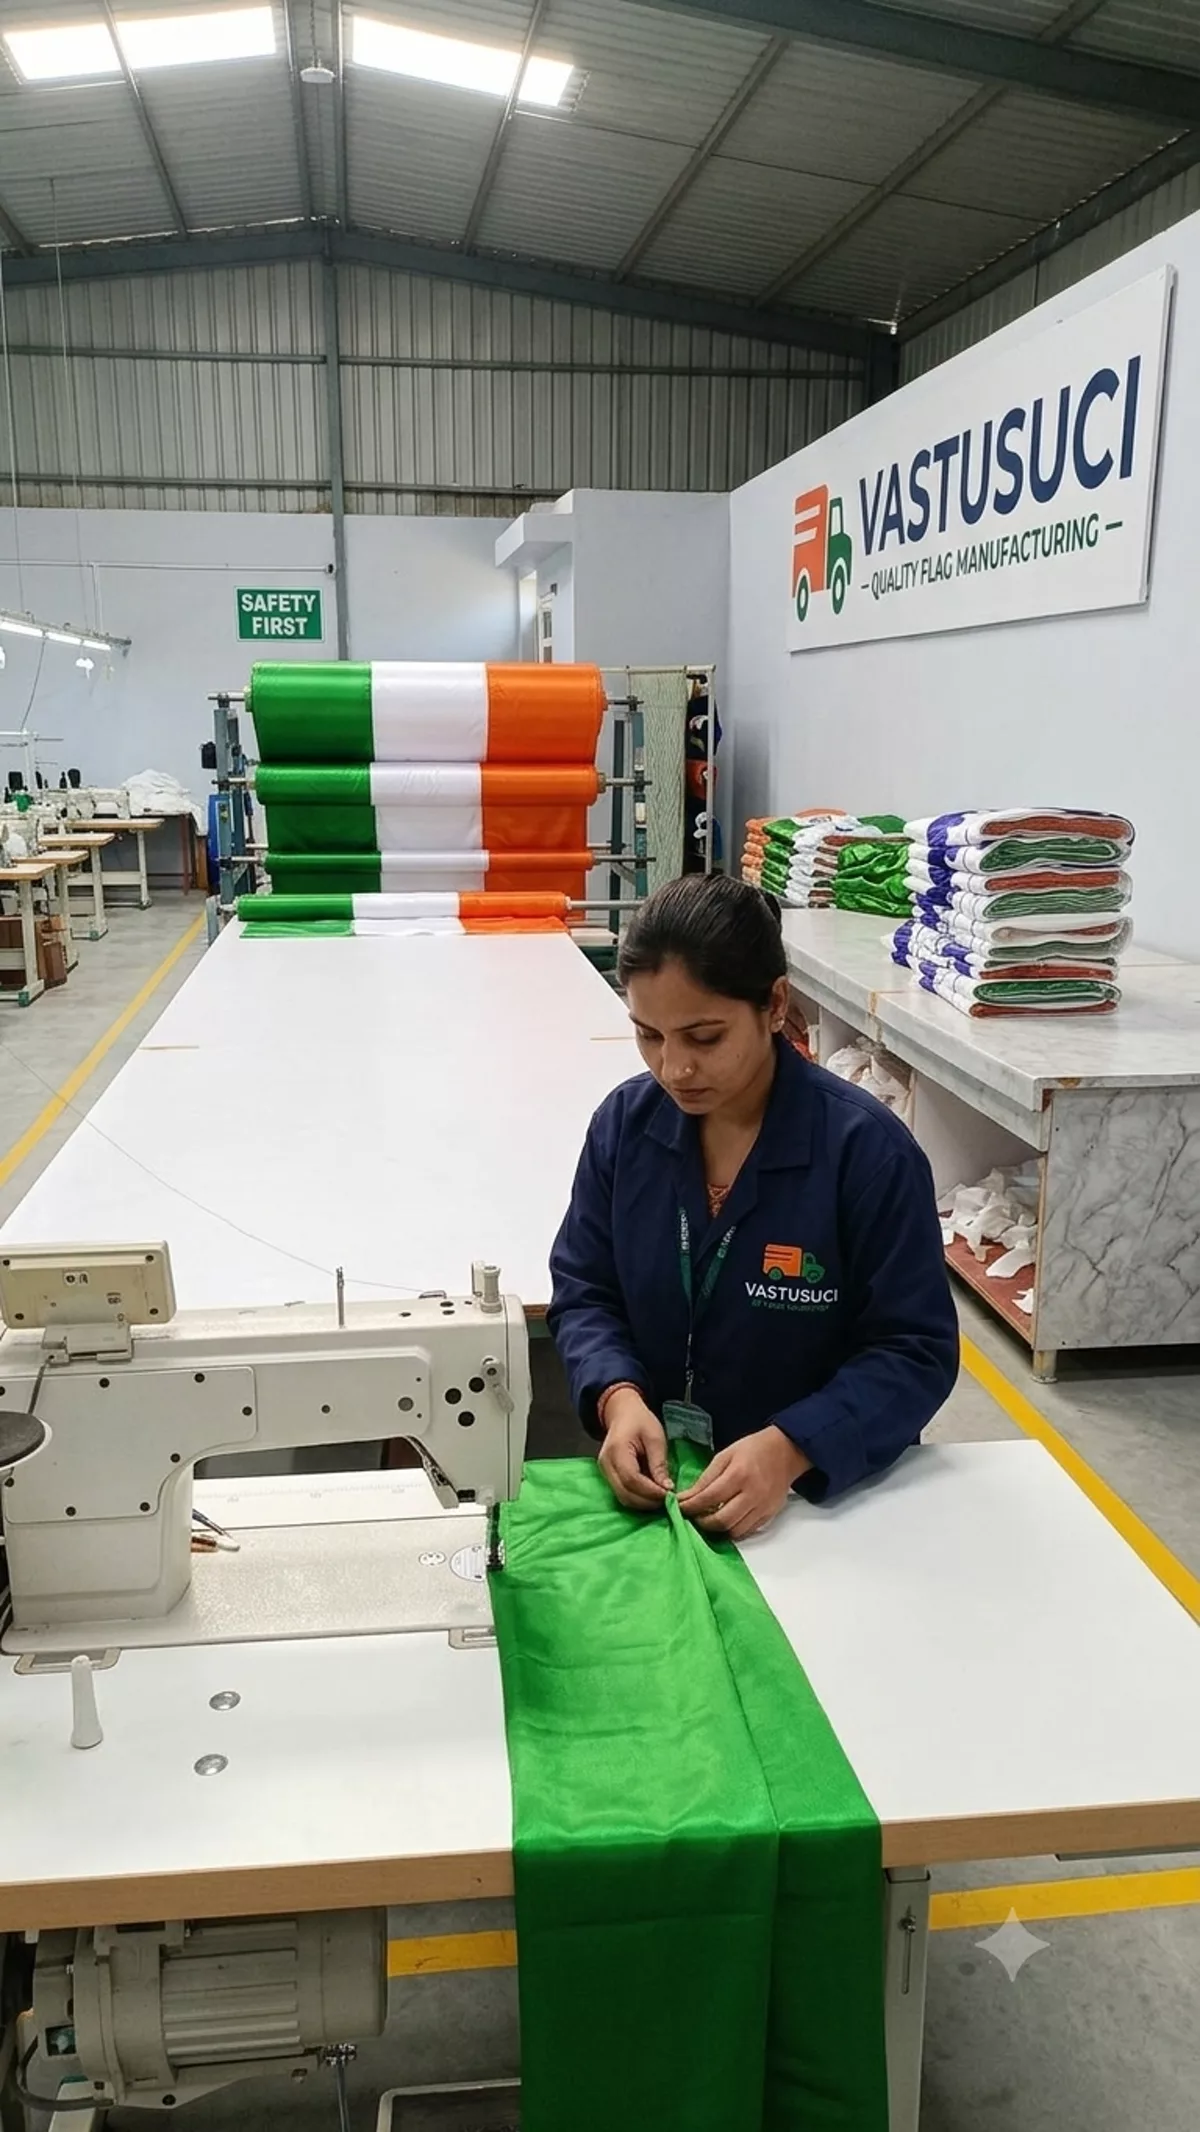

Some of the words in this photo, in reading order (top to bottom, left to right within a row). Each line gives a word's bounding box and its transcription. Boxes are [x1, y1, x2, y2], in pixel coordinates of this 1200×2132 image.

[859, 355, 1141, 556] VASTUSUCI
[871, 560, 920, 600] QUALITY
[921, 552, 953, 585] FLAG
[956, 513, 1099, 577] MANUFACTURING
[241, 593, 316, 612] SAFETY
[252, 617, 308, 635] FIRST
[745, 1282, 838, 1303] VASTUSUCI
